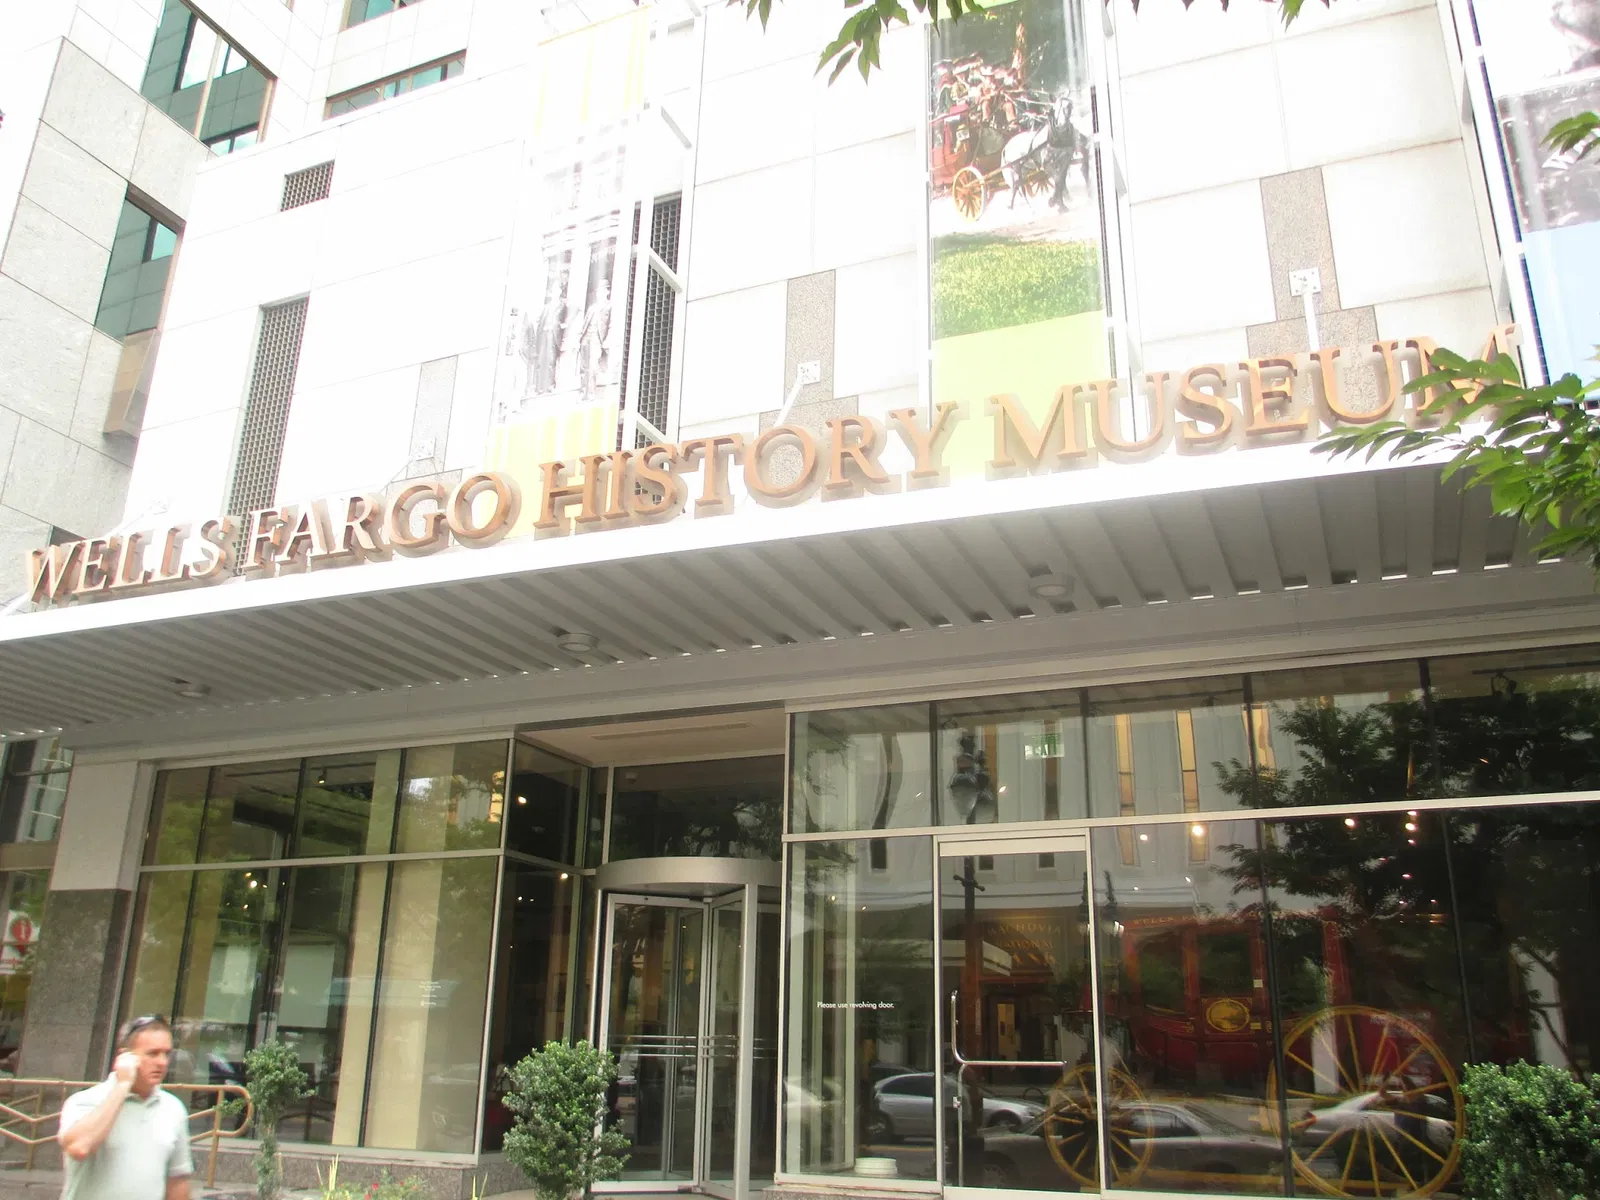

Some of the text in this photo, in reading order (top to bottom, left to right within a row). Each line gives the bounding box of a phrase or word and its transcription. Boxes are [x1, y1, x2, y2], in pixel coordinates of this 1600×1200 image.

[25, 322, 1522, 604] WELLS FARGO HISTORY MUSEUM
[817, 1001, 837, 1009] Please
[849, 1001, 877, 1010] revolving
[878, 1001, 895, 1009] door.
